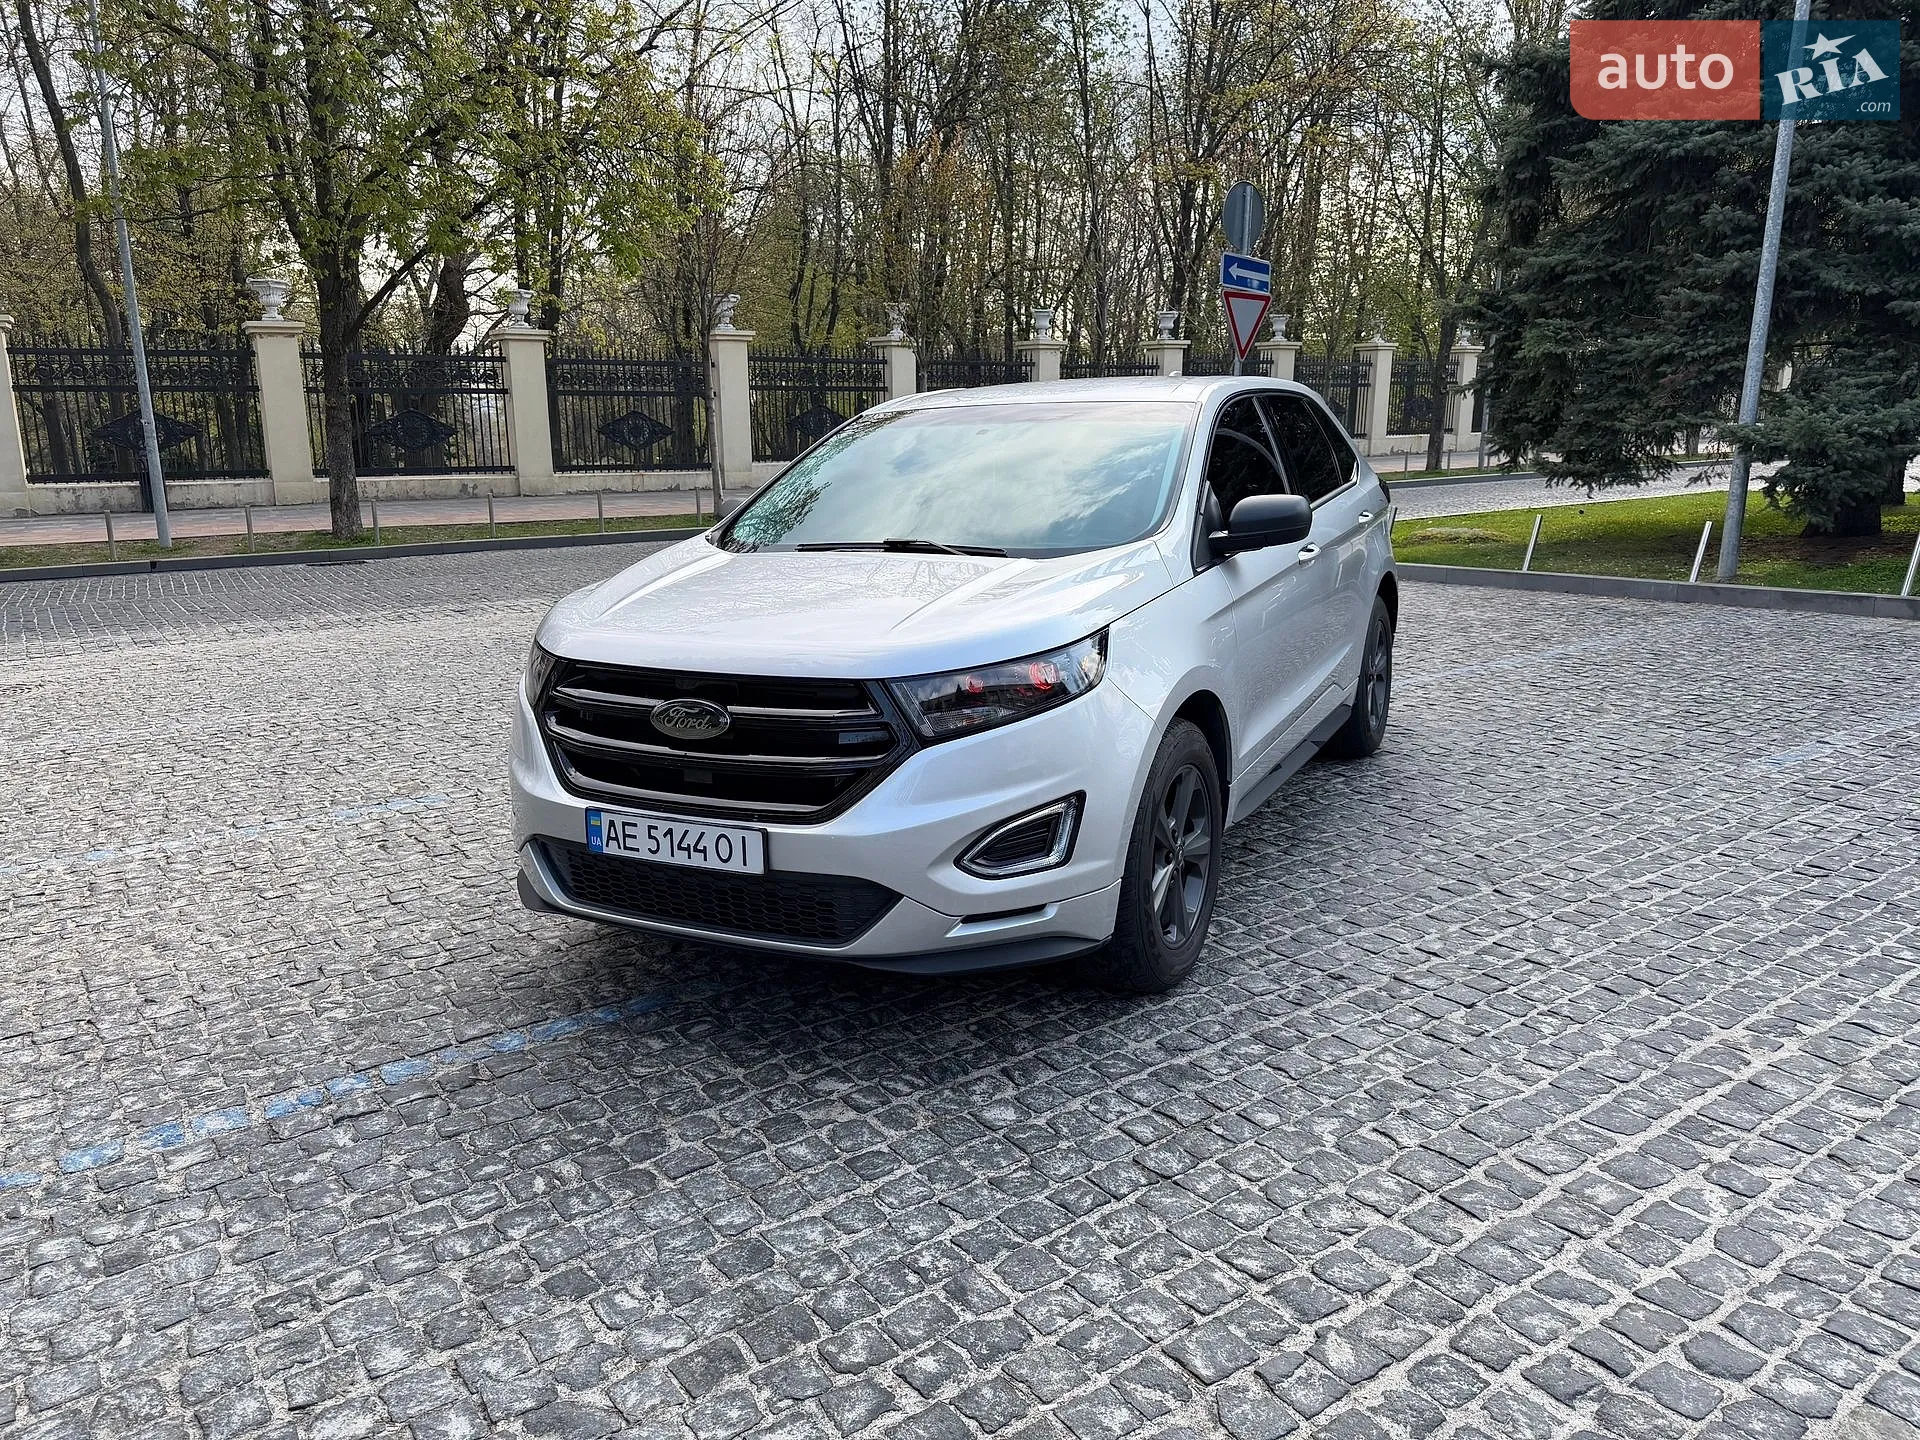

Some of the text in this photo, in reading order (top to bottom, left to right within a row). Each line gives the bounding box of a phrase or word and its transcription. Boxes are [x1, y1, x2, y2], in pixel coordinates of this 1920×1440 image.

[664, 706, 712, 730] Ford
[591, 836, 602, 847] UA
[605, 819, 640, 852] AE
[647, 825, 708, 861] 5144
